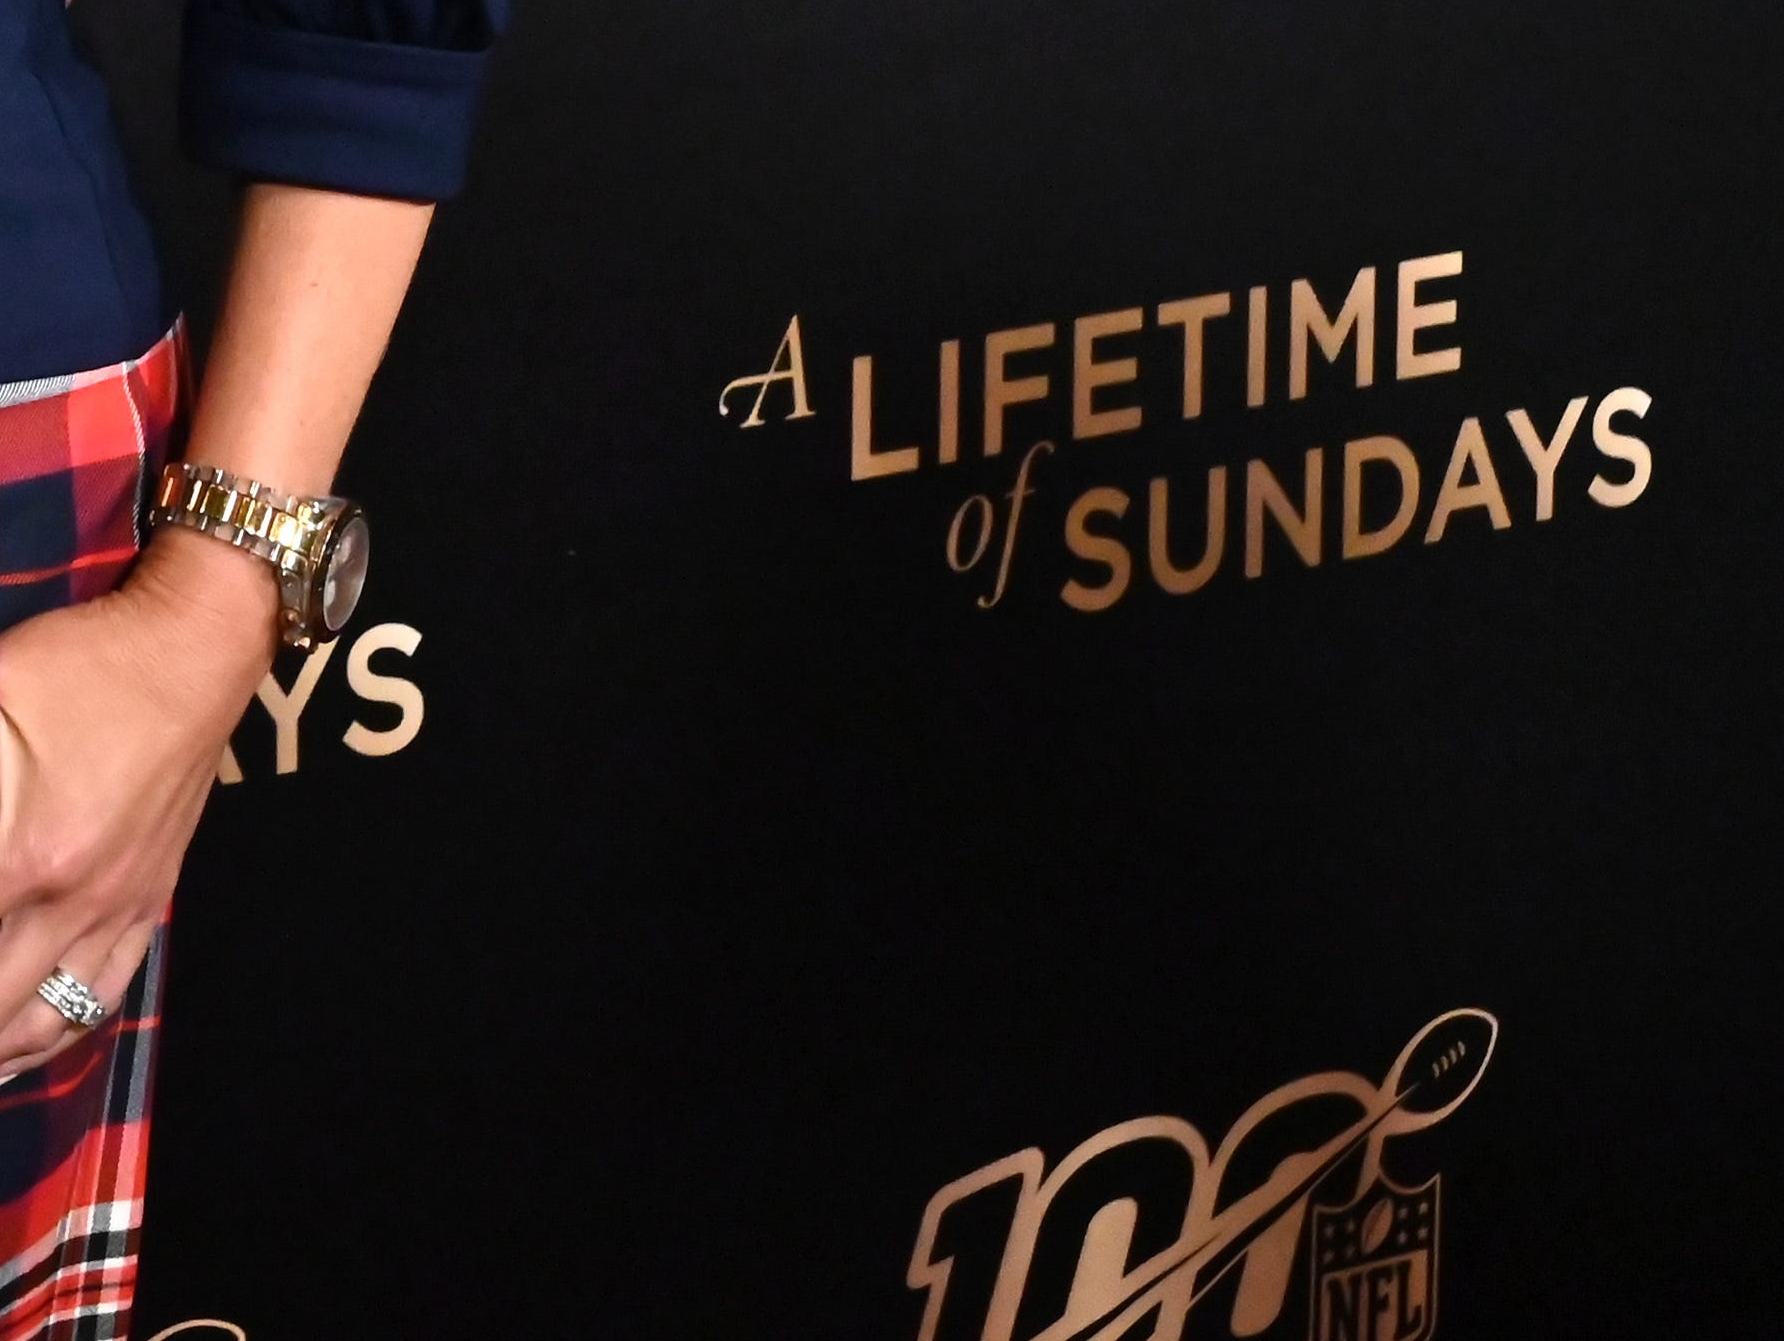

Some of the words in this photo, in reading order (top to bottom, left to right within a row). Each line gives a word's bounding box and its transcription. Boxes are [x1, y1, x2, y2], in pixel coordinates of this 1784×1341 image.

[718, 313, 817, 430] A
[851, 249, 1465, 482] LIFETIME
[945, 440, 1055, 609] of
[1060, 385, 1654, 613] SUNDAYS
